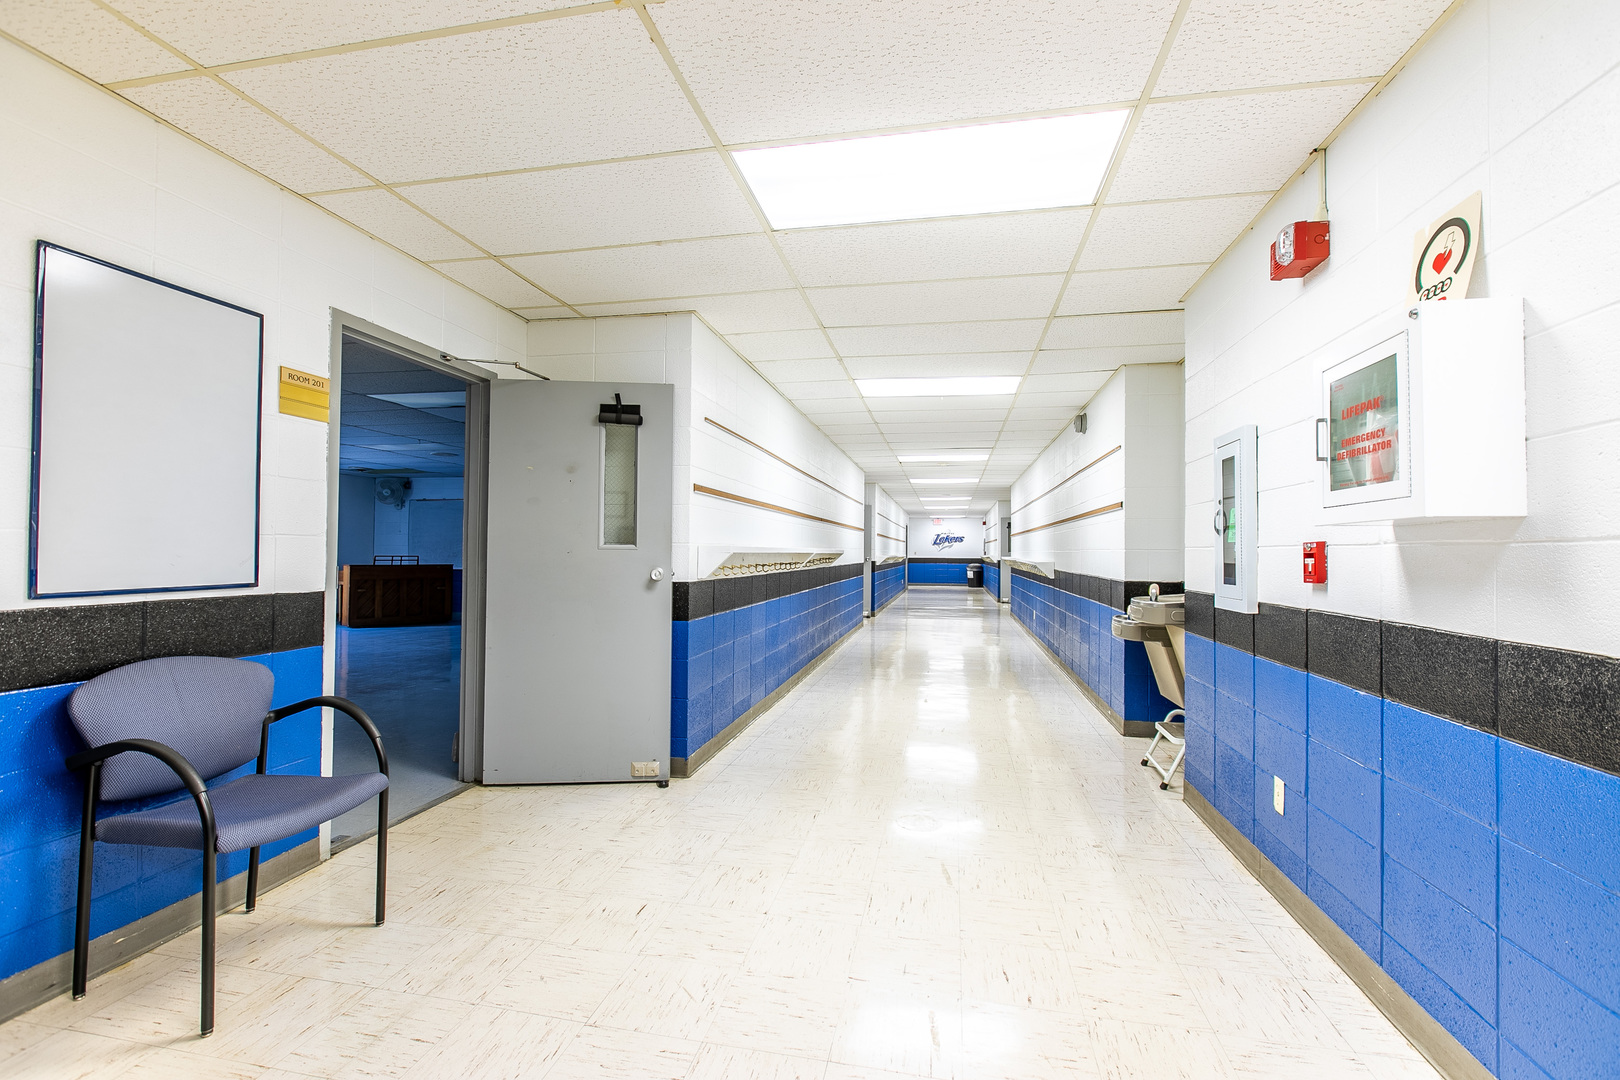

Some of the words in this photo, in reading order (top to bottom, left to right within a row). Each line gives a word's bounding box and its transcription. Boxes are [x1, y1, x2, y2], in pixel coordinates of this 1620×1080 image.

[288, 373, 310, 384] ROOM
[312, 379, 324, 388] 201
[1341, 427, 1385, 448] EMERGENCY
[1336, 439, 1392, 461] DEFIBRILLATOR
[932, 534, 965, 546] Lakers
